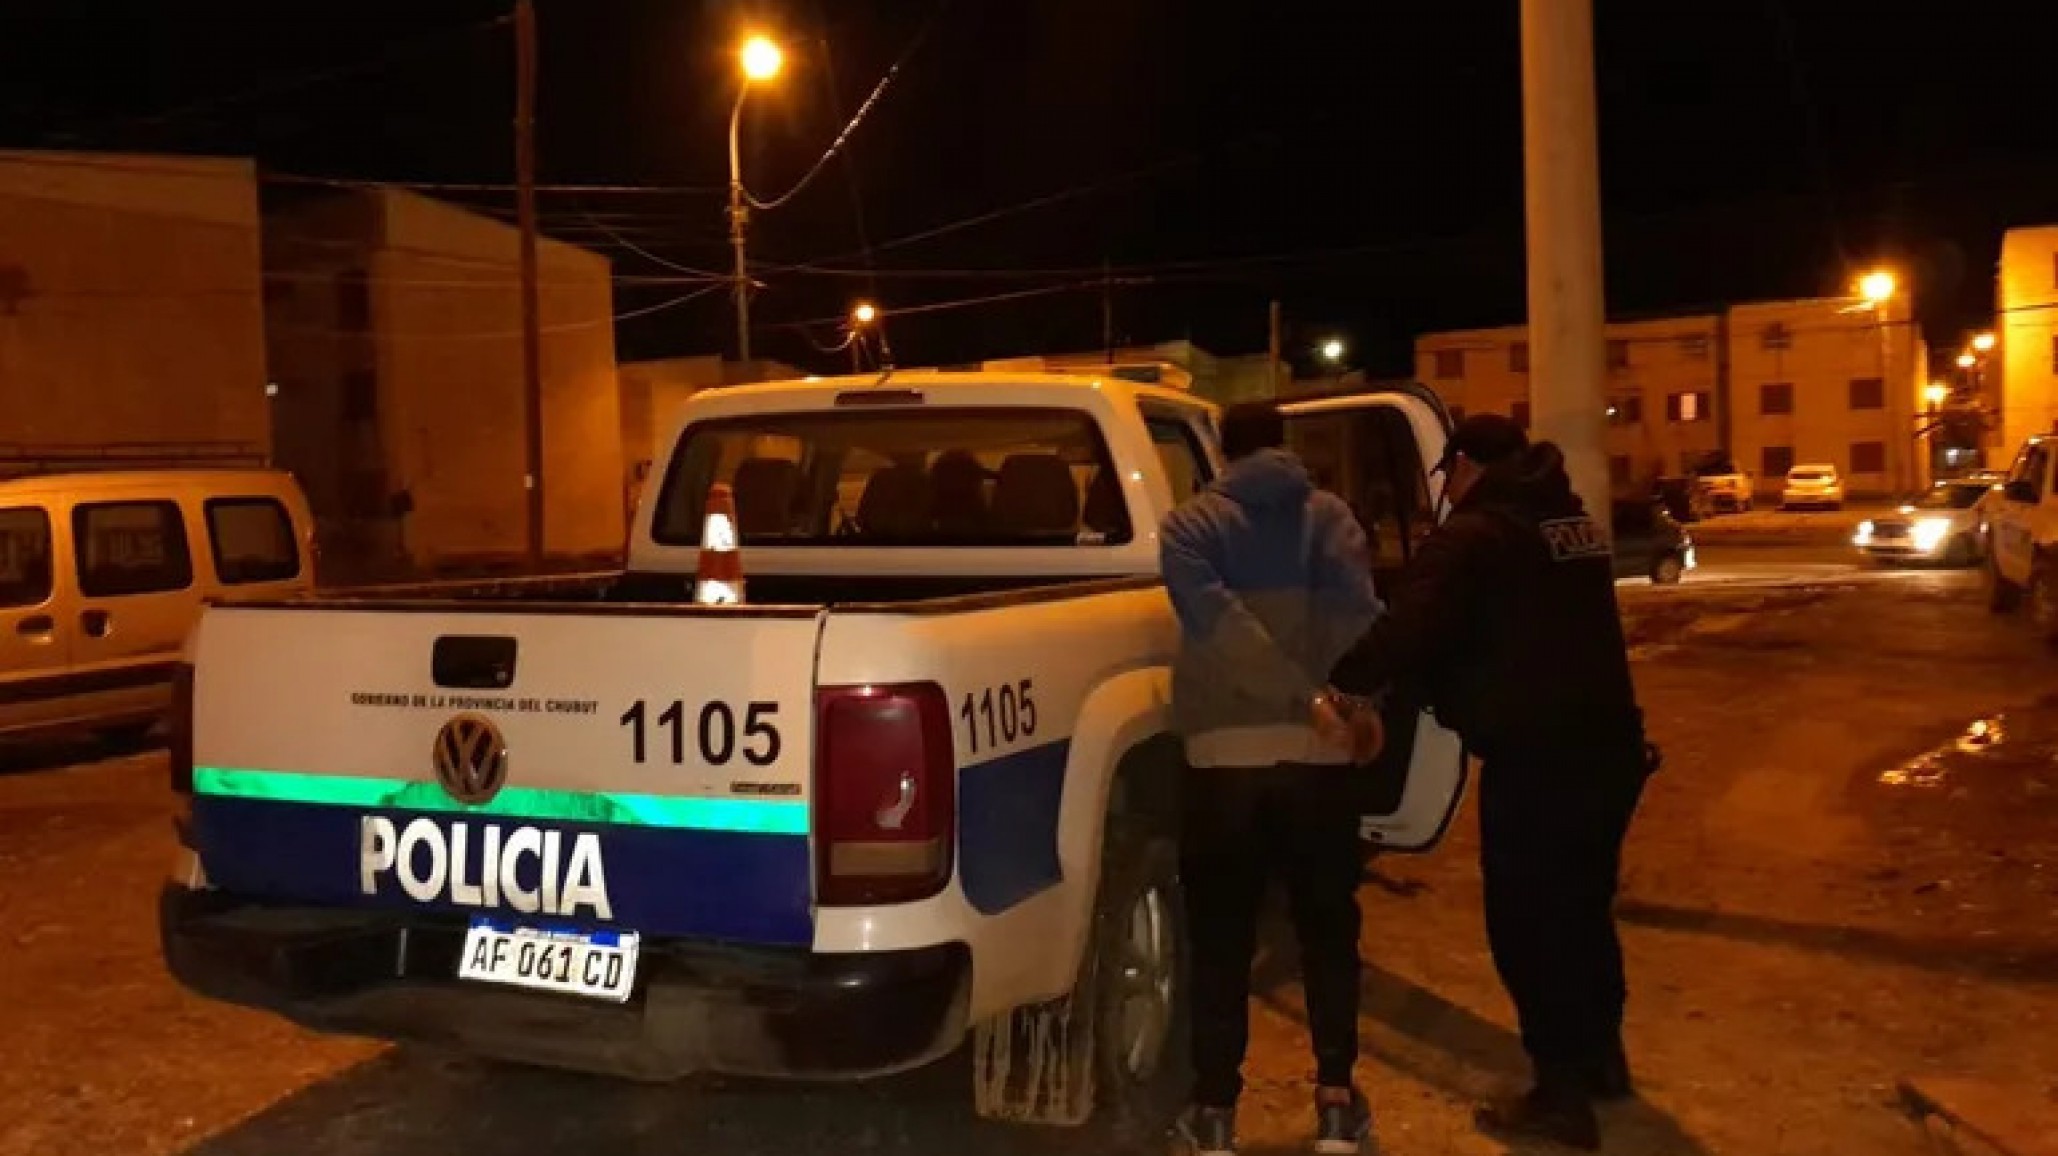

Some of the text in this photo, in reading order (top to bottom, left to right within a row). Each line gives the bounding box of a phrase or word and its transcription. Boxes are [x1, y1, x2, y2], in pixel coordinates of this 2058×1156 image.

[352, 692, 598, 714] GOBIERNO DE LA PROVINCIA DEL CHUBUT
[620, 699, 781, 766] 1105
[961, 679, 1036, 754] 1105
[361, 815, 612, 920] POLICIA
[470, 936, 623, 989] AF 061 CD
